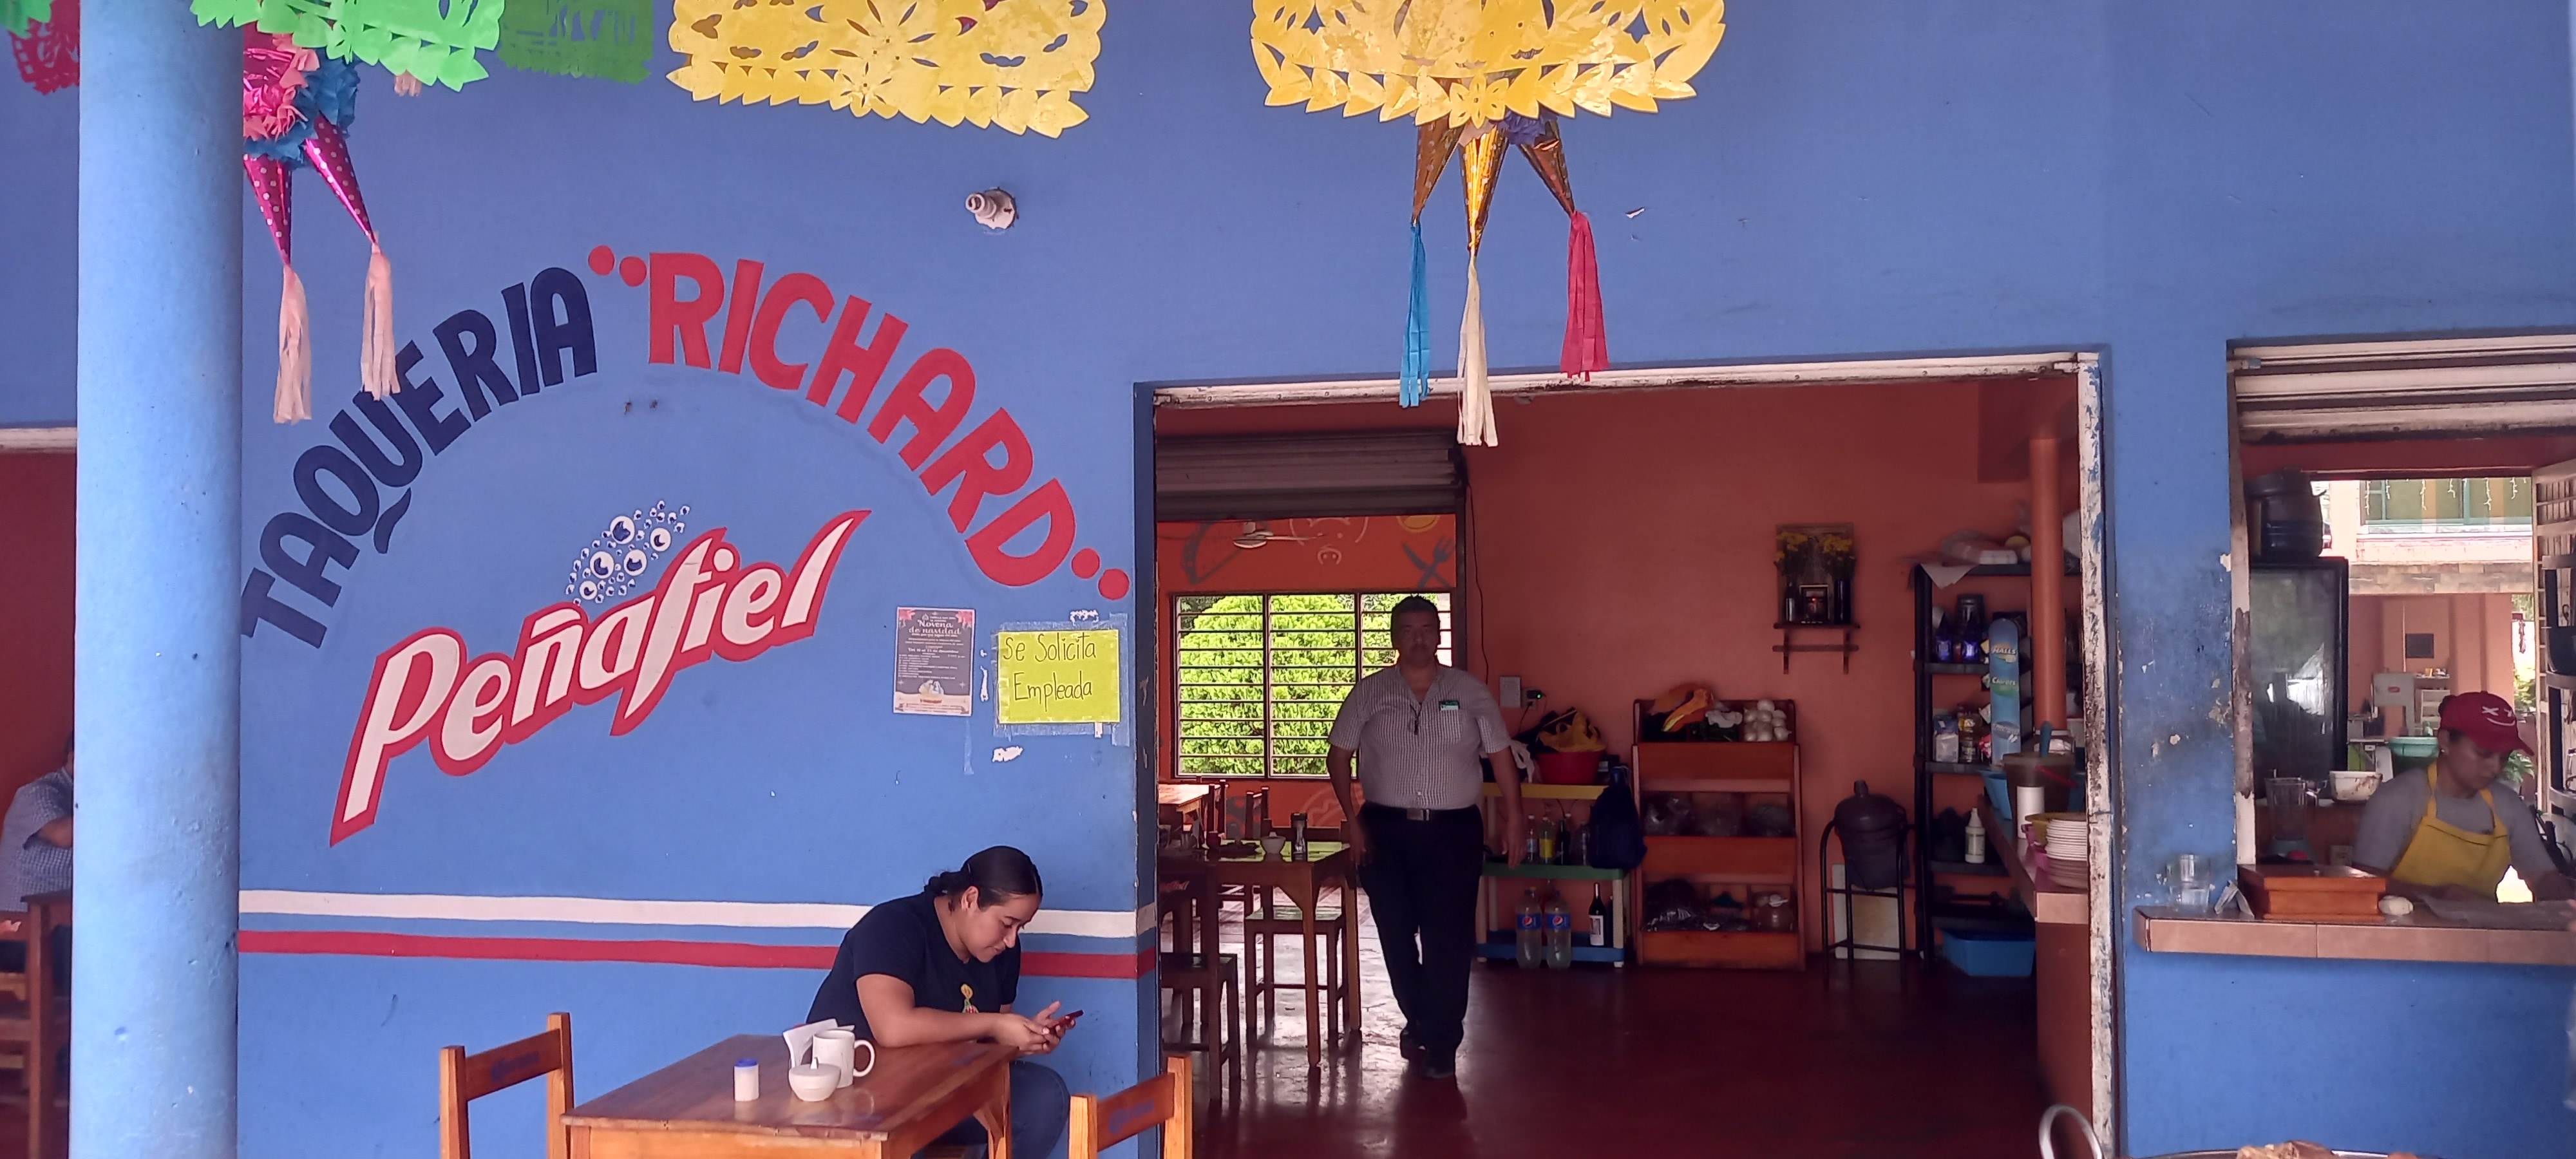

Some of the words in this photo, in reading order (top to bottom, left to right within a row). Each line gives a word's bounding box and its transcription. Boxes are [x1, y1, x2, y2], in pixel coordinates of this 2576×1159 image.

[241, 267, 597, 649] TAQUERIA
[917, 619, 954, 628] Novena
[1003, 637, 1025, 661] Se
[1034, 632, 1097, 663] Solicita
[330, 509, 872, 847] Peñafiel
[1013, 670, 1093, 712] Empleada
